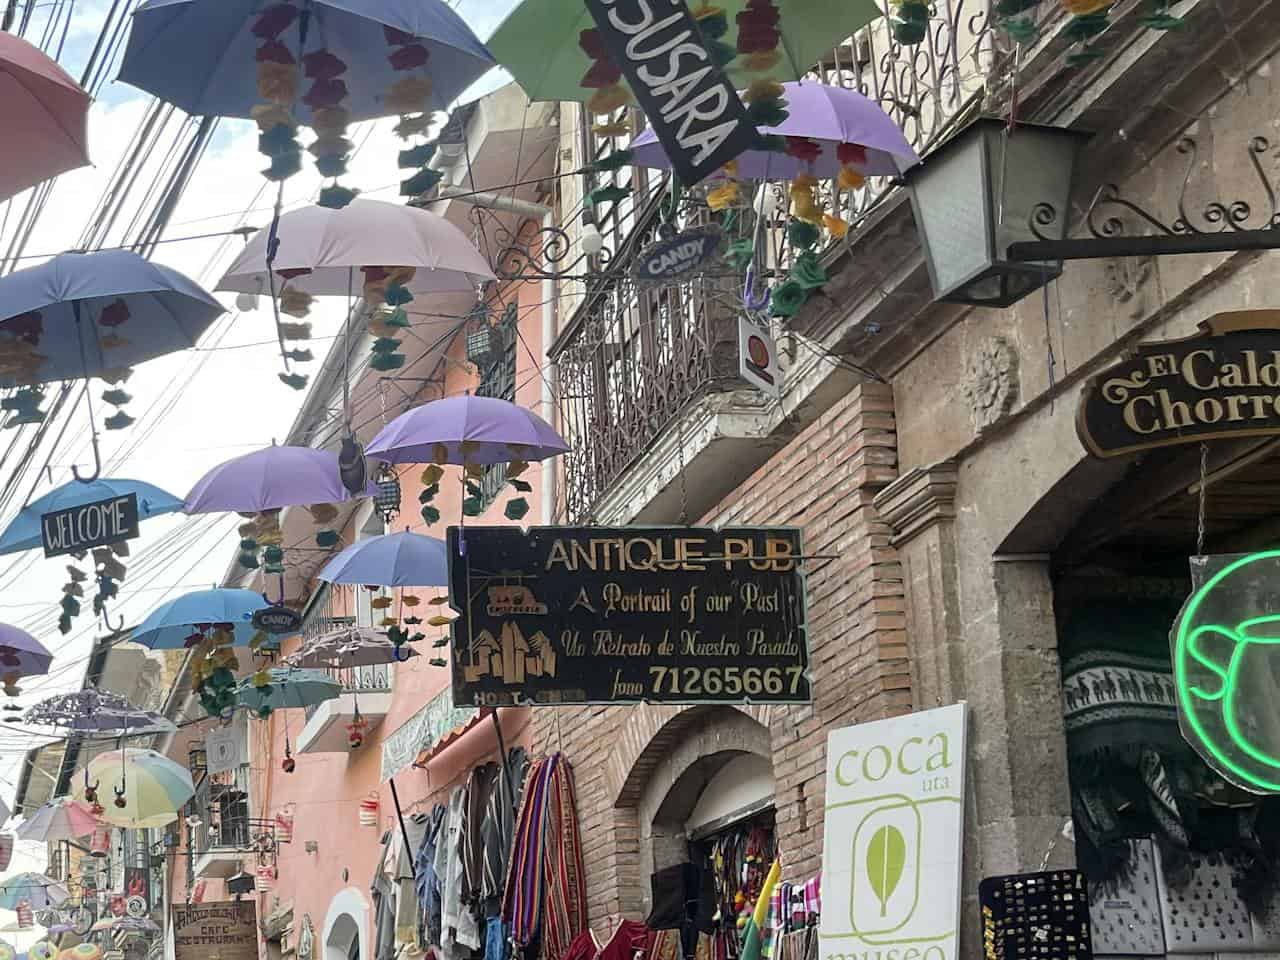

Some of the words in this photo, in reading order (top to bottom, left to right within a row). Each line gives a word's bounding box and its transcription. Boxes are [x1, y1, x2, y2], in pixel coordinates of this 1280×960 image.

[648, 238, 704, 274] CANDY
[1145, 354, 1179, 377] El
[45, 498, 129, 550] WELCOME
[545, 538, 707, 572] ANTIQUE
[724, 538, 794, 572] PUB
[569, 585, 596, 613] A
[602, 582, 671, 619] Portrait
[681, 585, 698, 623] of
[706, 591, 732, 613] our
[262, 614, 293, 626] CANDY
[592, 630, 650, 657] Retrato
[657, 631, 674, 656] de
[680, 630, 740, 657] Nuestro
[746, 629, 799, 657] Pasado
[649, 665, 803, 696] 71265667
[834, 732, 952, 787] coca
